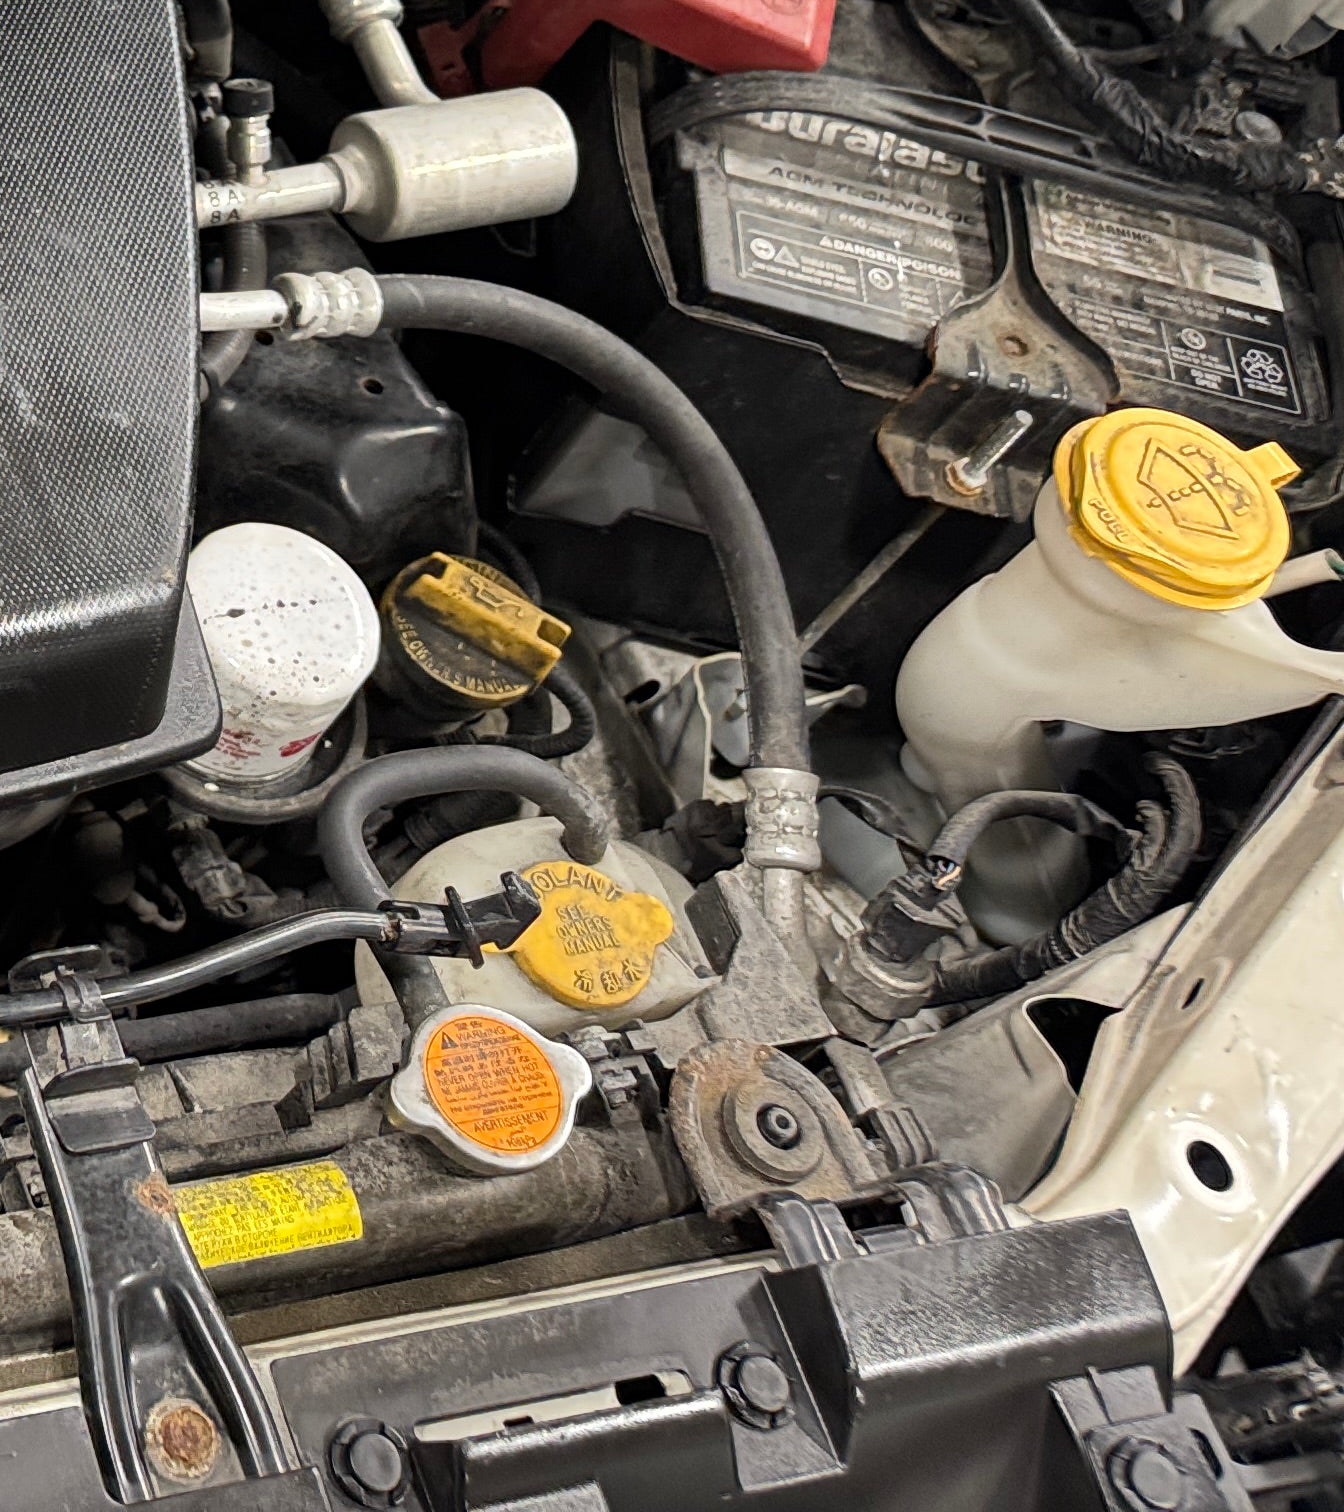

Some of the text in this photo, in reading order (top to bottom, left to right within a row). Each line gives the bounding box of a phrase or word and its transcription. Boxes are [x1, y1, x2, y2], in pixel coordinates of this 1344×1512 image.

[768, 165, 979, 226] AGM TECHNOLOG
[532, 866, 625, 902] OLANT
[556, 903, 591, 922] SEE
[563, 934, 621, 956] MANUAL
[456, 1025, 506, 1041] WARNING
